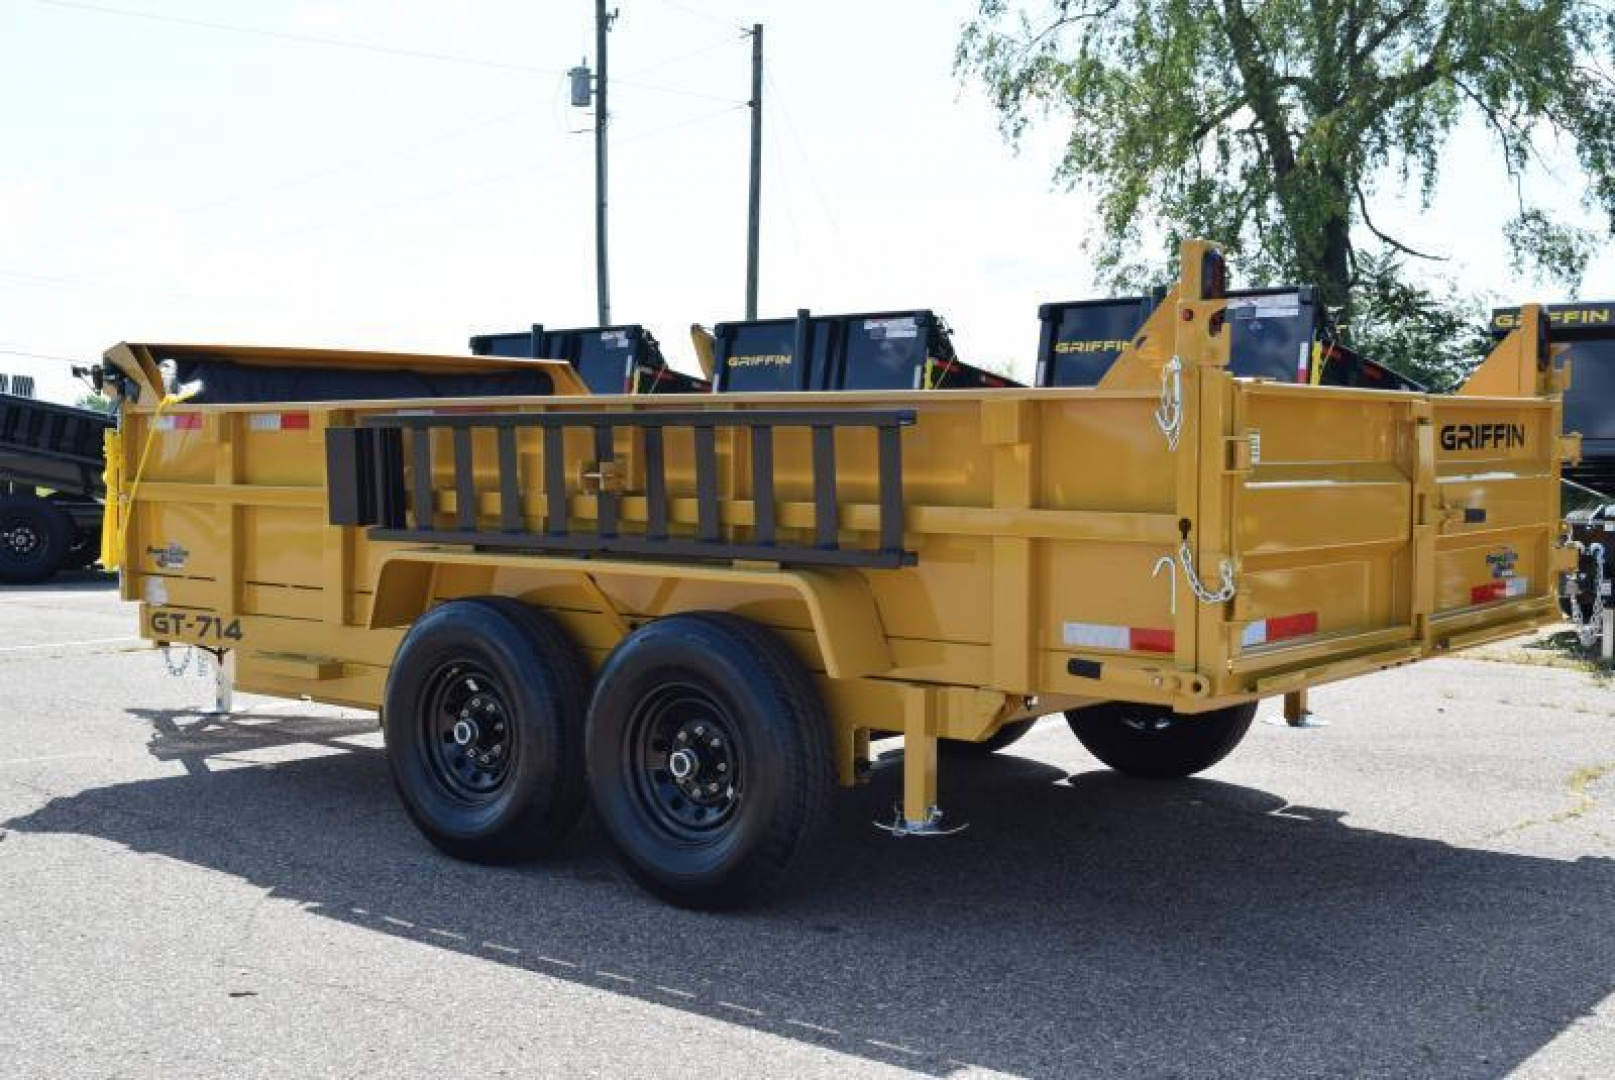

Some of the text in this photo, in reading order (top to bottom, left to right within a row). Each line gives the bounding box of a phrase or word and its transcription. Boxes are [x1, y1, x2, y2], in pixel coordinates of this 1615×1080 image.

[728, 354, 792, 367] GRIFFIN
[1440, 423, 1525, 451] GRIFFIN
[151, 612, 243, 641] GT-714
